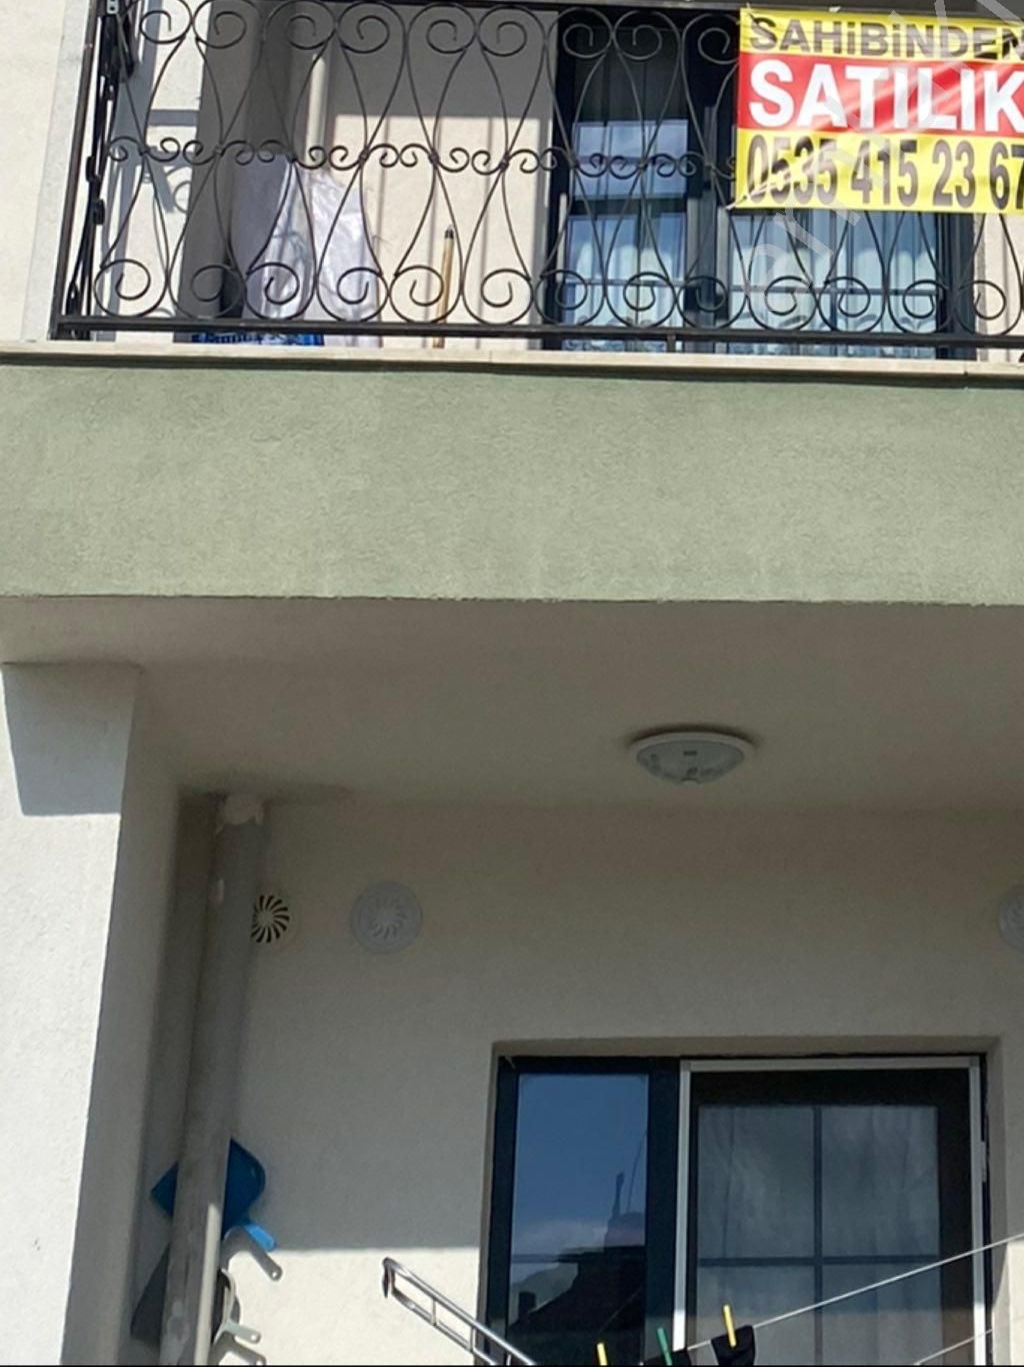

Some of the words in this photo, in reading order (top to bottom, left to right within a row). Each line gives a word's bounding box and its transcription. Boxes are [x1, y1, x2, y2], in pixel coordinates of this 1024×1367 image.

[747, 134, 839, 204] 0535
[851, 138, 918, 207] 415
[931, 137, 977, 209] 23
